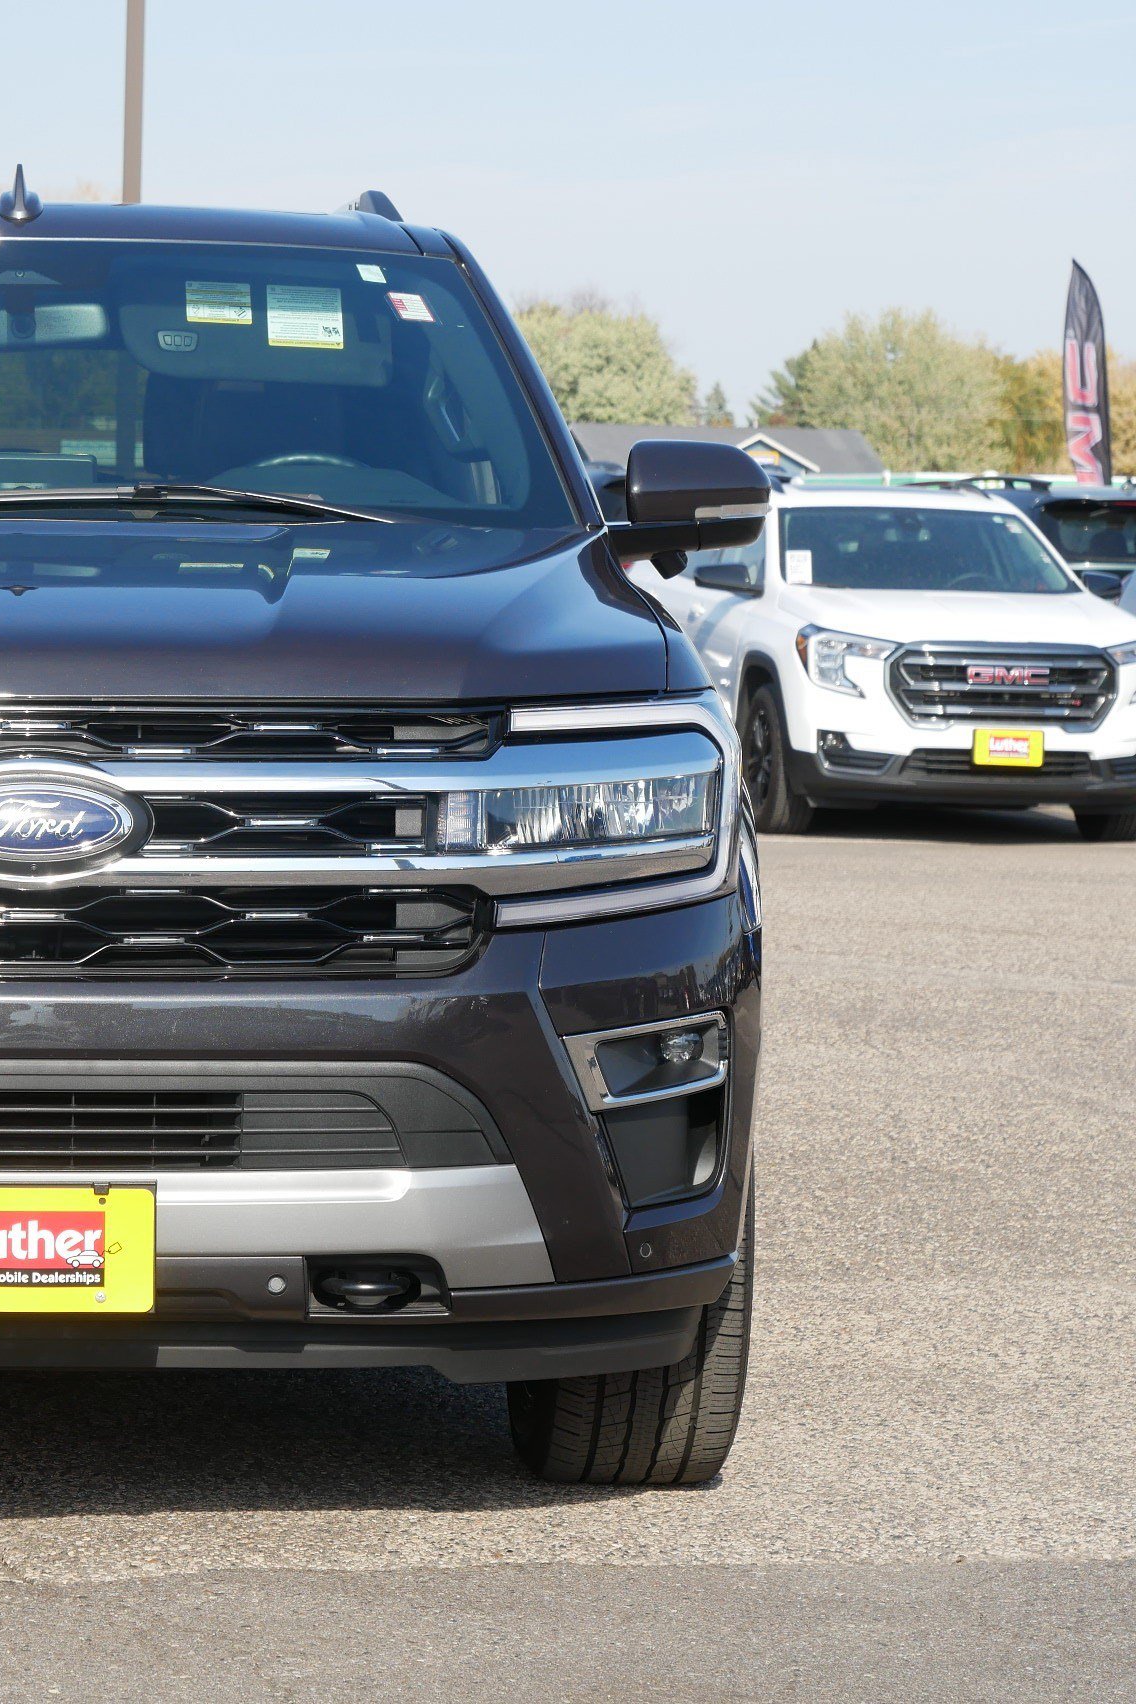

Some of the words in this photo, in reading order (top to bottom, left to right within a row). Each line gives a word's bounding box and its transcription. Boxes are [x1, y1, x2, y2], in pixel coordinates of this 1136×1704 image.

[1065, 337, 1104, 486] MC
[967, 665, 1050, 685] GMC
[32, 1271, 101, 1285] Dealerships
